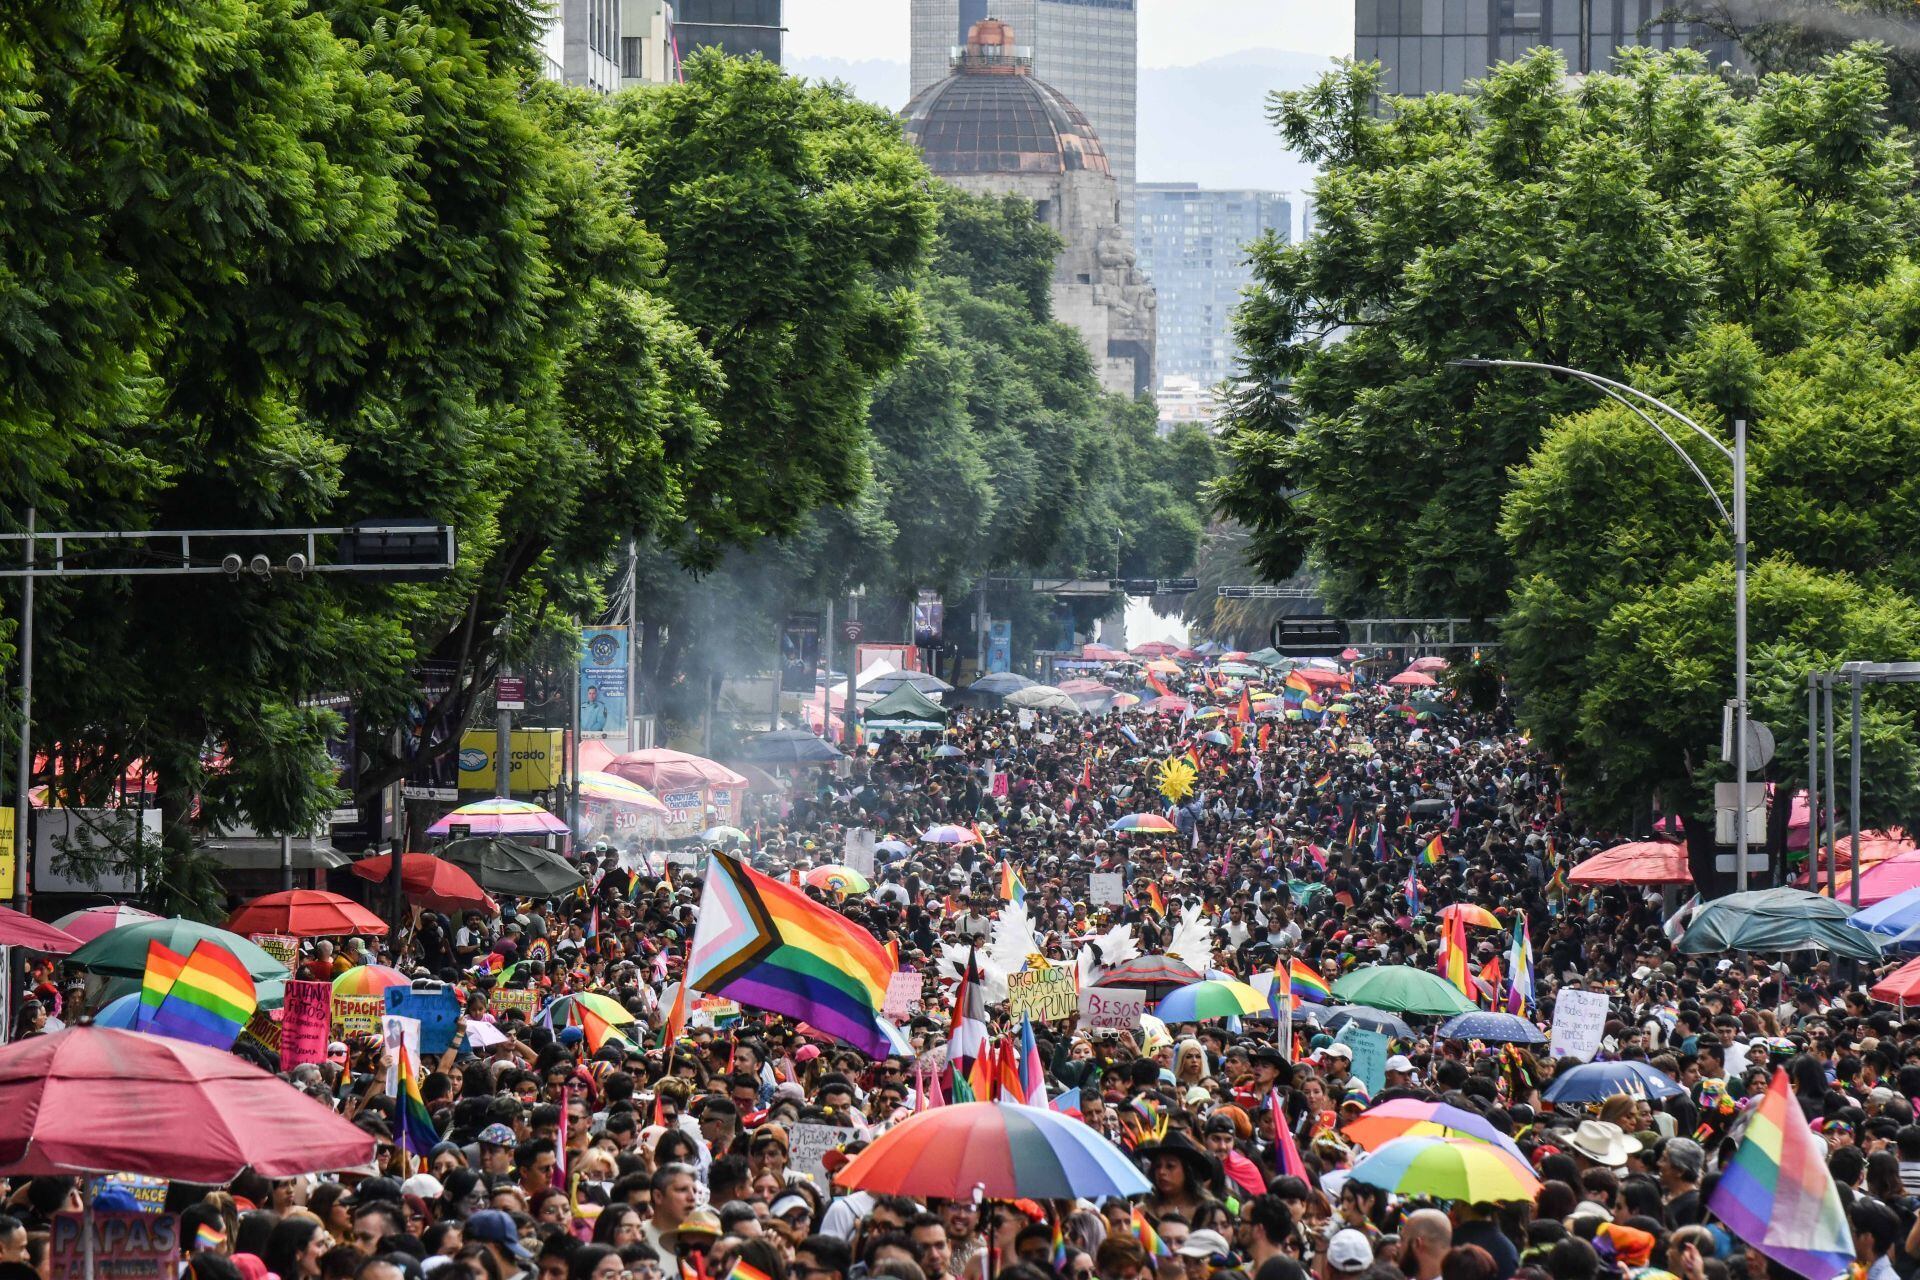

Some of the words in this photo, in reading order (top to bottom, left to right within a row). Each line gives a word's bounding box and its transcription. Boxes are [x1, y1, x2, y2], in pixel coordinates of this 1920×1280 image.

[616, 813, 636, 828] $10
[1008, 966, 1074, 987] ORGULLOSA
[492, 990, 538, 1002] ELOTES
[1046, 981, 1059, 994] DE
[1061, 979, 1074, 993] UN
[334, 998, 385, 1017] TEPACHE
[1010, 998, 1035, 1018] GAY
[1039, 993, 1078, 1019] PUNTO
[1088, 994, 1141, 1017] BESOS
[1091, 1016, 1131, 1028] GRATIS
[55, 1215, 176, 1253] PAPAS
